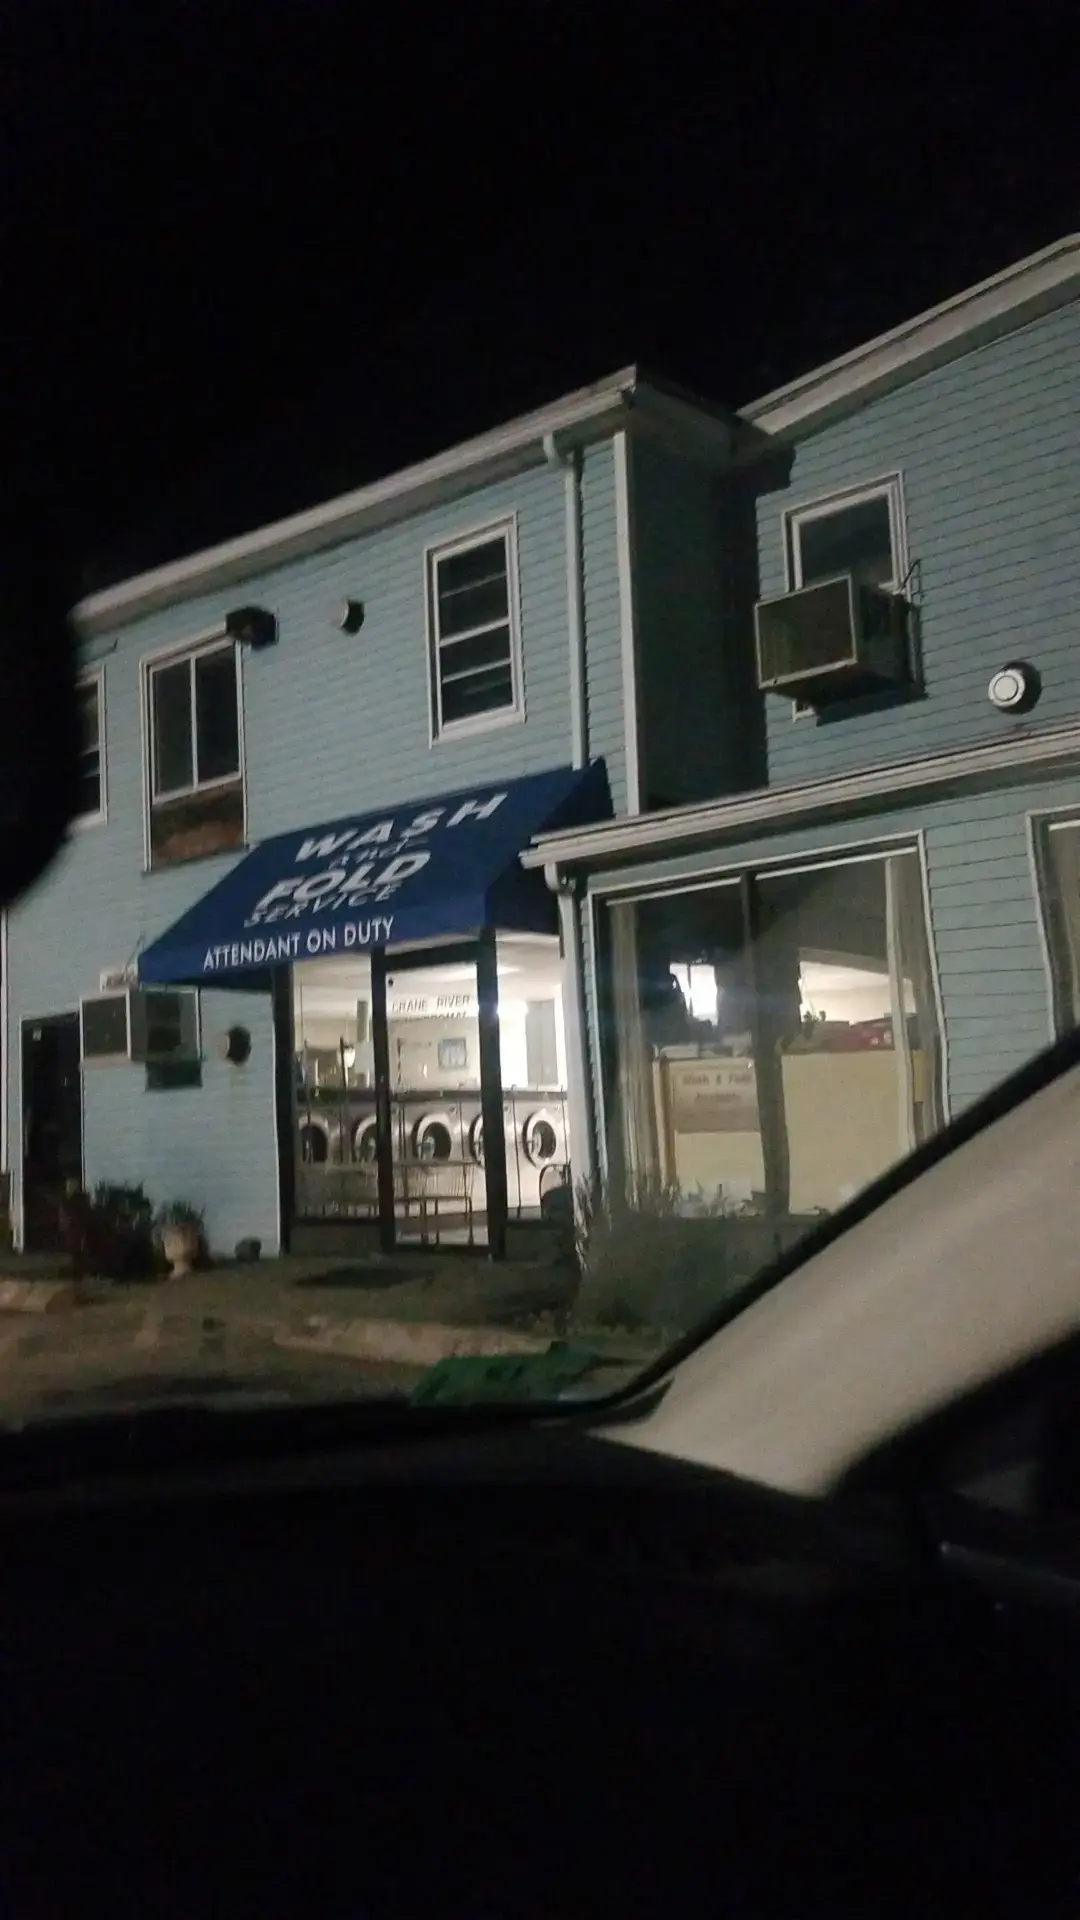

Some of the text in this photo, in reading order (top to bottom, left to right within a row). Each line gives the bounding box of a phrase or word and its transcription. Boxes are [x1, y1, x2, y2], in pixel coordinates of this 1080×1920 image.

[295, 792, 508, 862] WASH
[243, 880, 401, 928] SERVICE
[255, 851, 431, 912] FOLD
[203, 916, 394, 972] ATTENDANT ON DUTY
[437, 994, 470, 1009] RIVER
